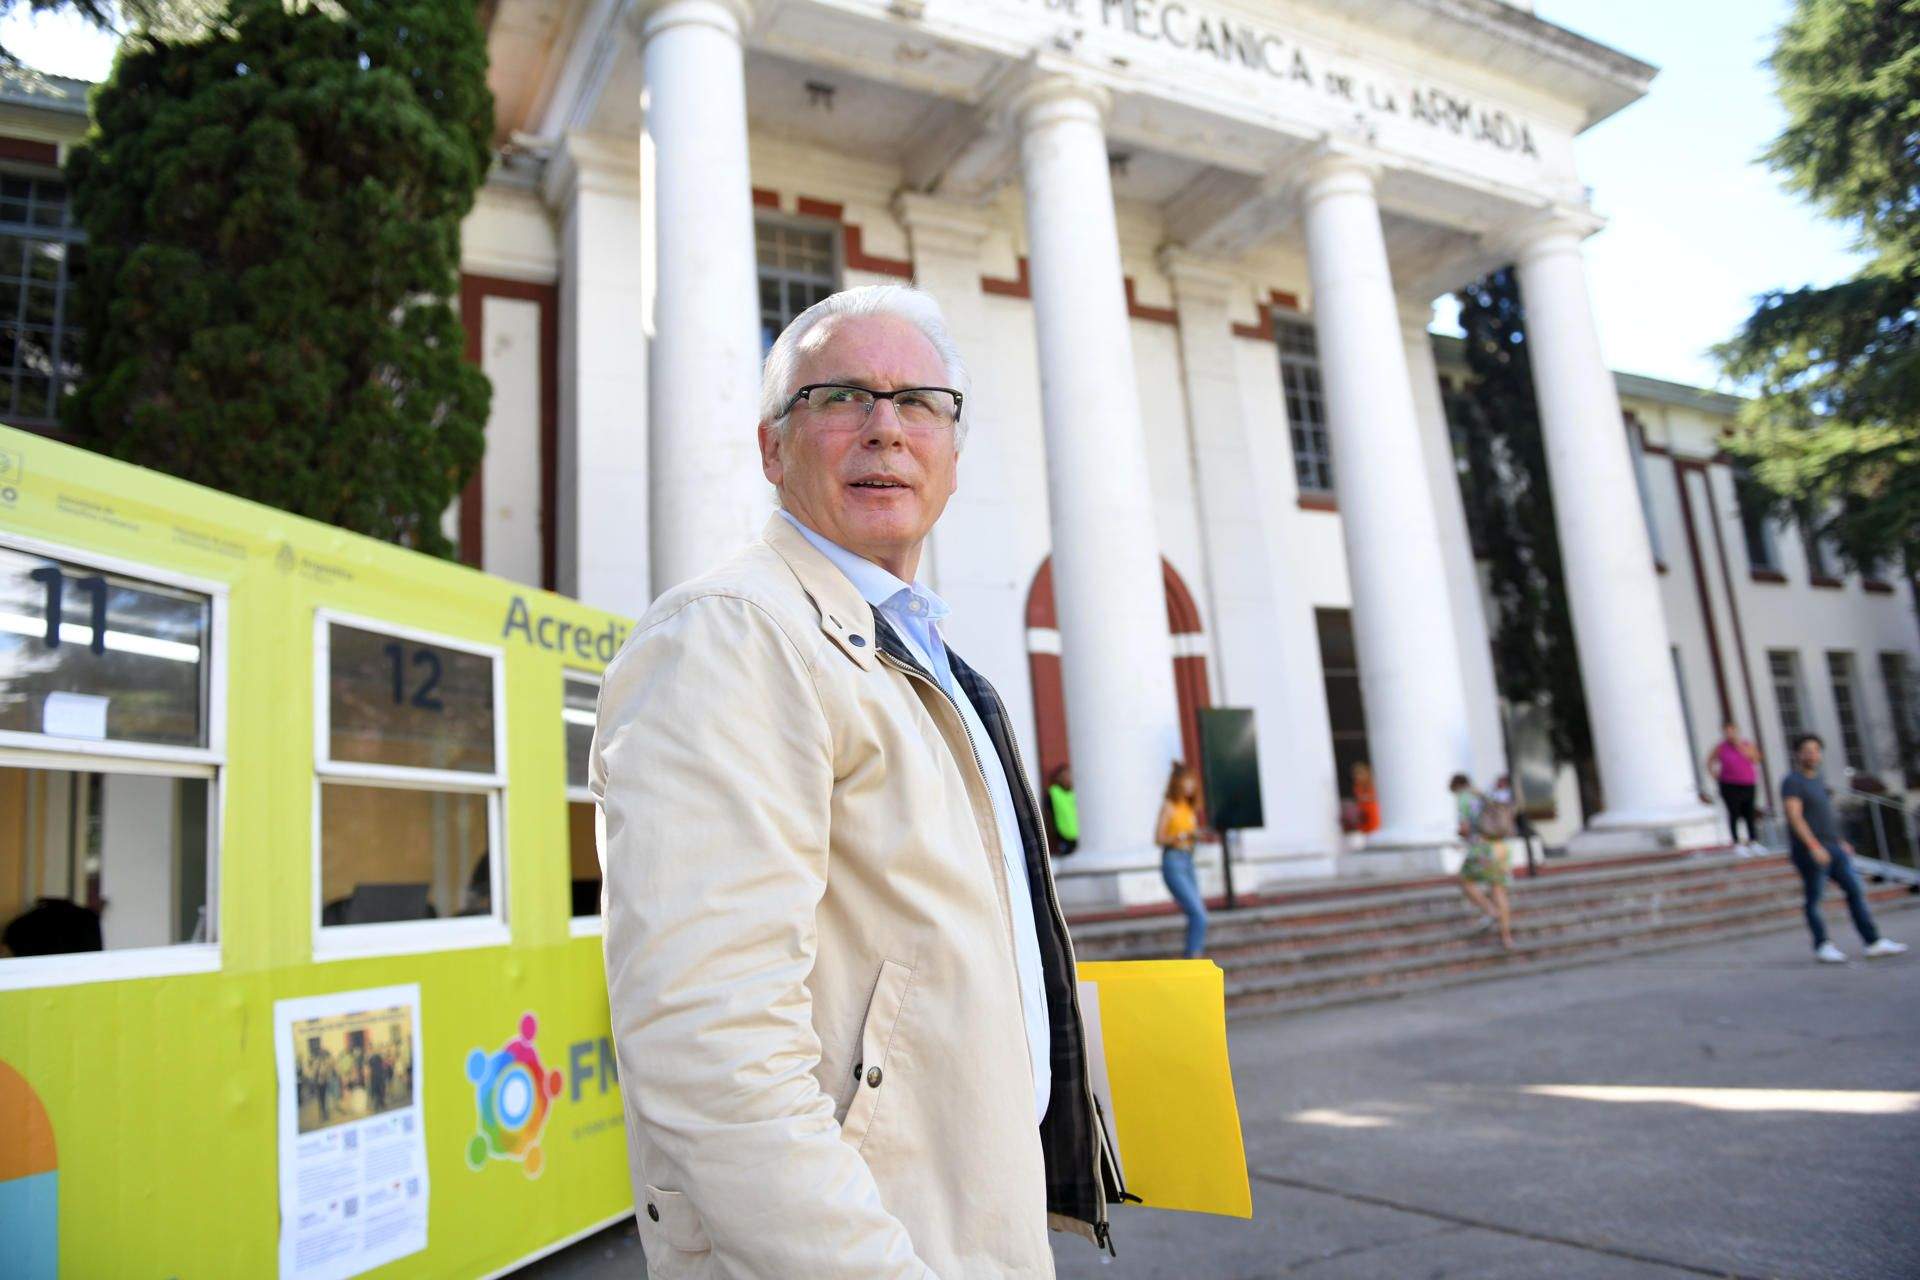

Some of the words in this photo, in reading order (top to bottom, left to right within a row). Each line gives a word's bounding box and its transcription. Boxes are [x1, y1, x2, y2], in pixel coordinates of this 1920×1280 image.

[1102, 0, 1313, 86] MECANICA
[1366, 85, 1397, 113] LA
[1410, 88, 1541, 158] ARMADA
[31, 567, 107, 656] 11
[384, 643, 444, 714] 12
